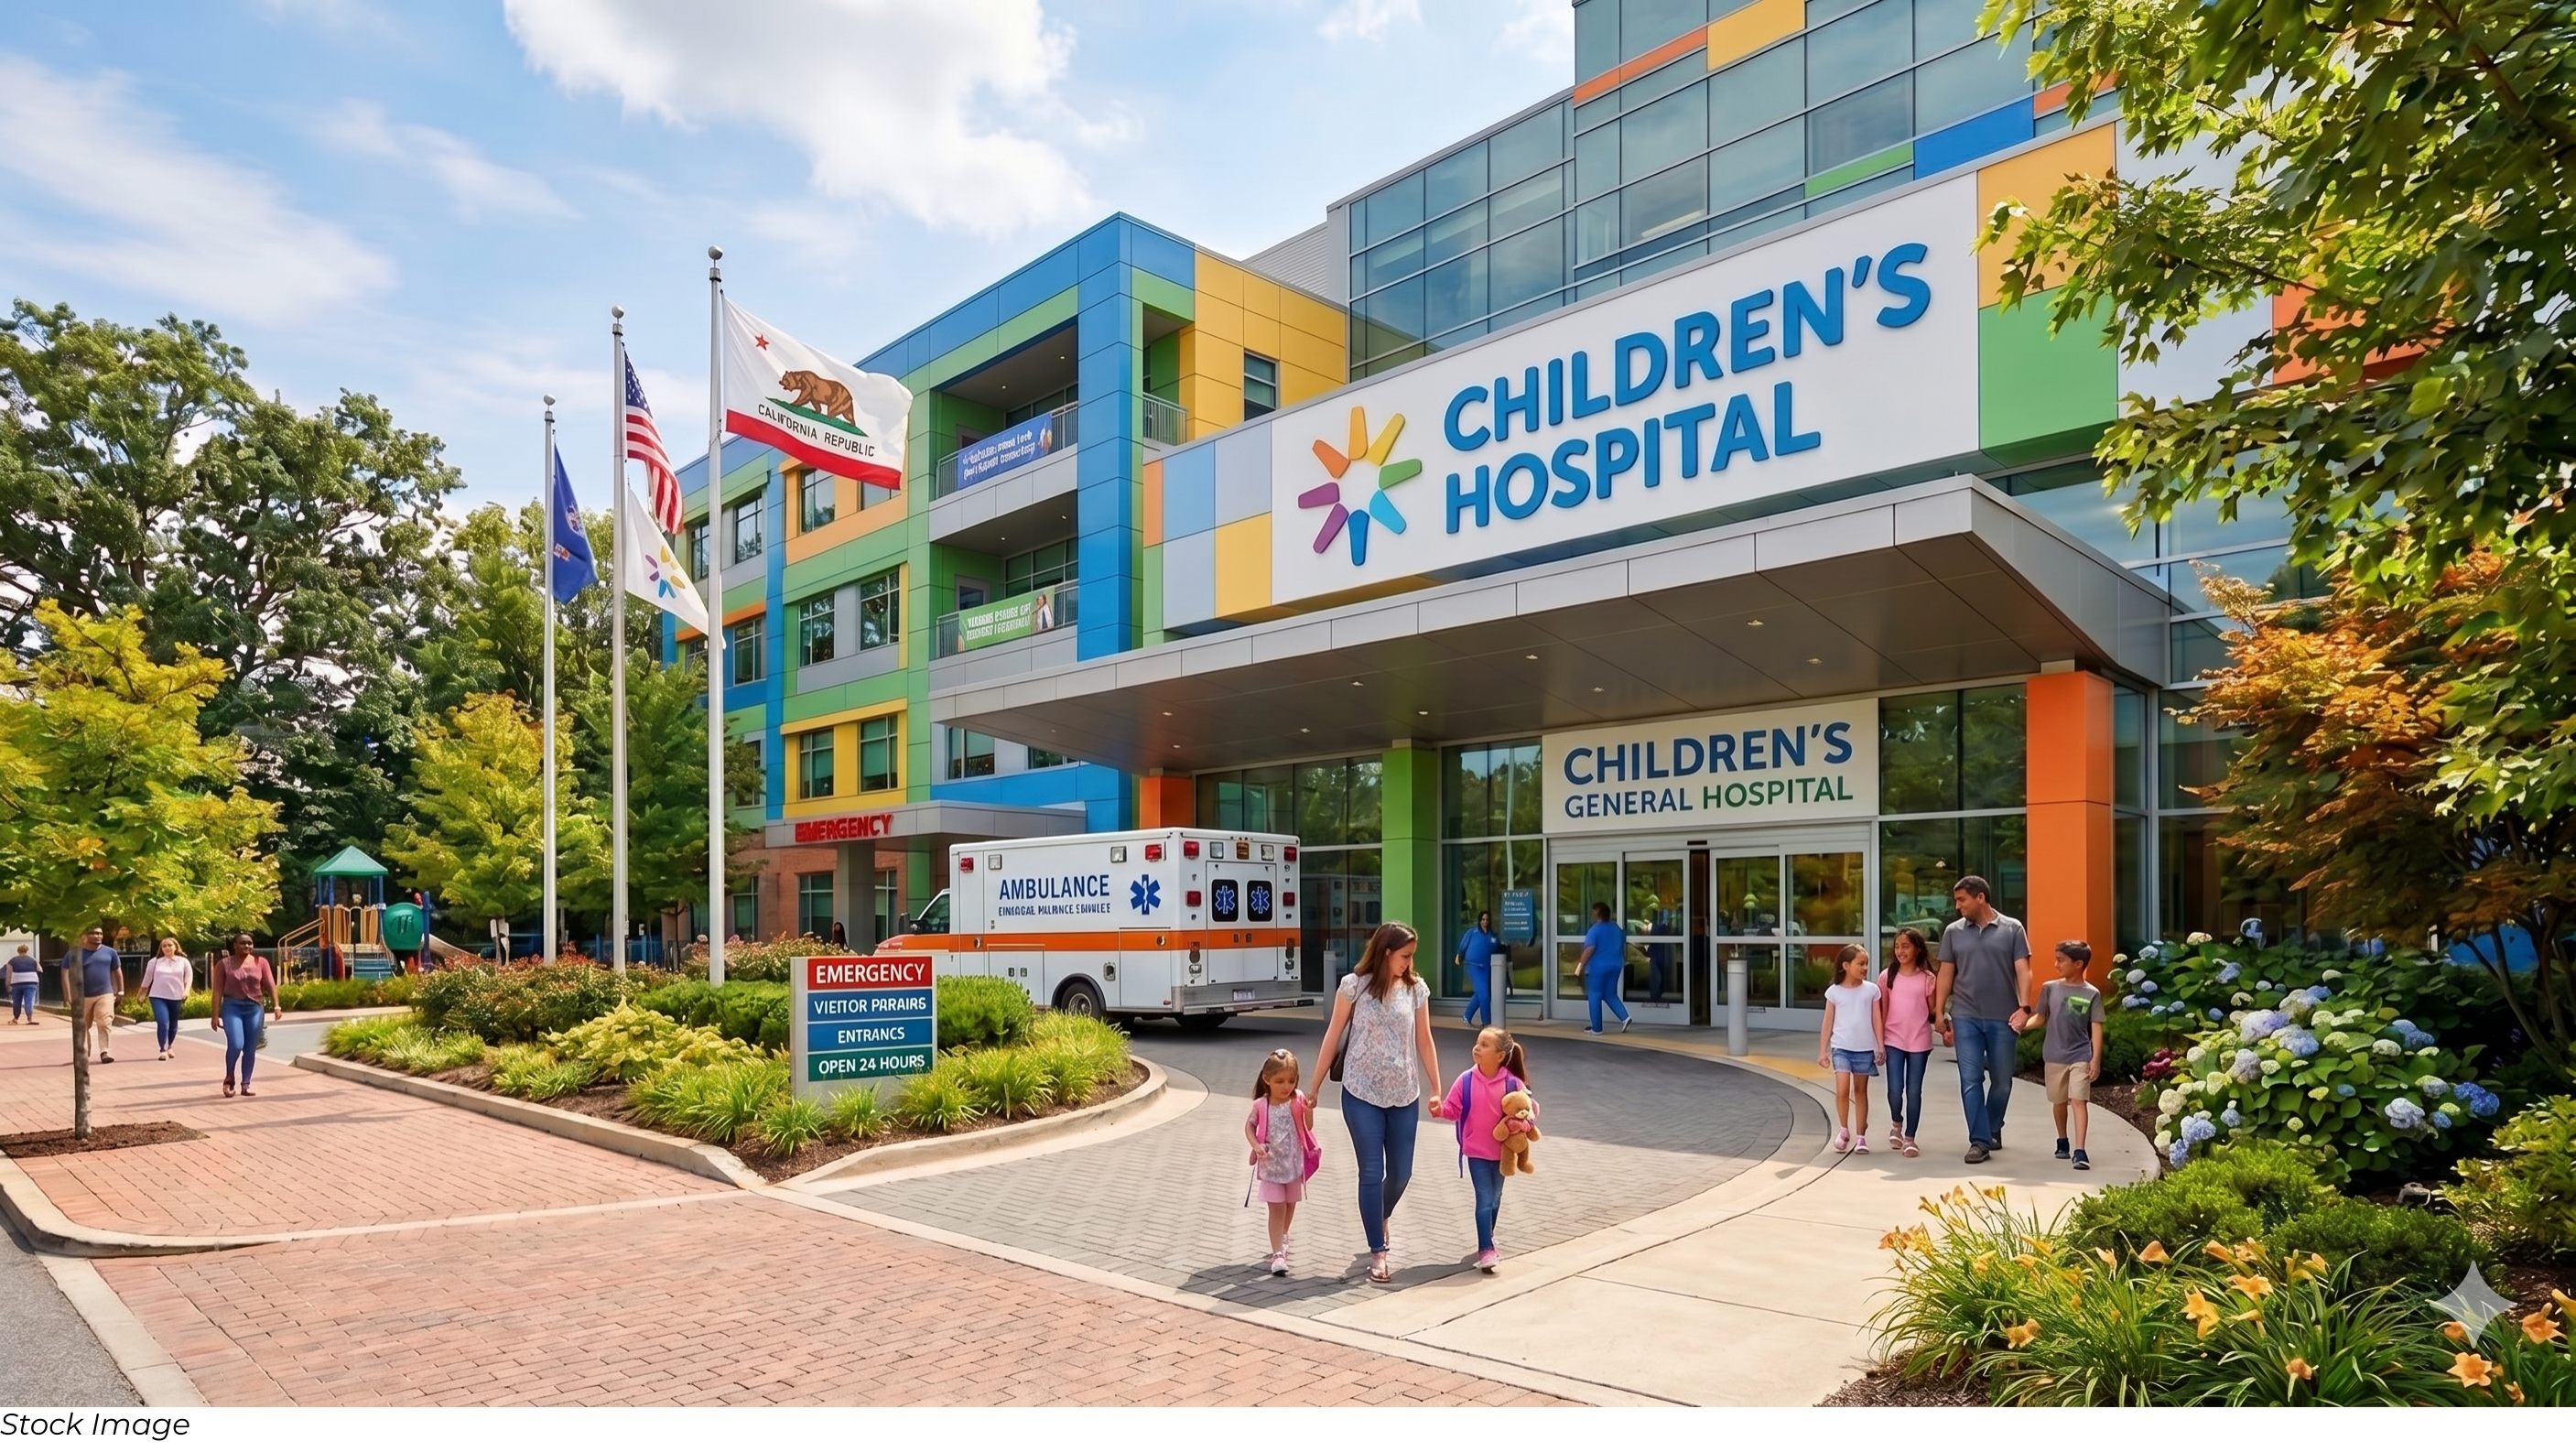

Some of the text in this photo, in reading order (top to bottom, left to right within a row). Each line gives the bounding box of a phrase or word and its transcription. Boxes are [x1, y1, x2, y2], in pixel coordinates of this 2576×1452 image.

[1444, 242, 1932, 451] CHILDREN'S
[758, 404, 875, 457] CALIFORNIA REPUBLIC
[1445, 381, 1821, 535] HOSPITAL
[1564, 721, 1854, 785] CHILDREN'S
[1564, 775, 1854, 818] GENERAL HOSPITAL
[795, 814, 893, 843] EMERGENCY
[999, 874, 1110, 900] AMBULANCE
[816, 963, 925, 984] EMERGENCY
[818, 1055, 925, 1075] OPEN 24 HOURS
